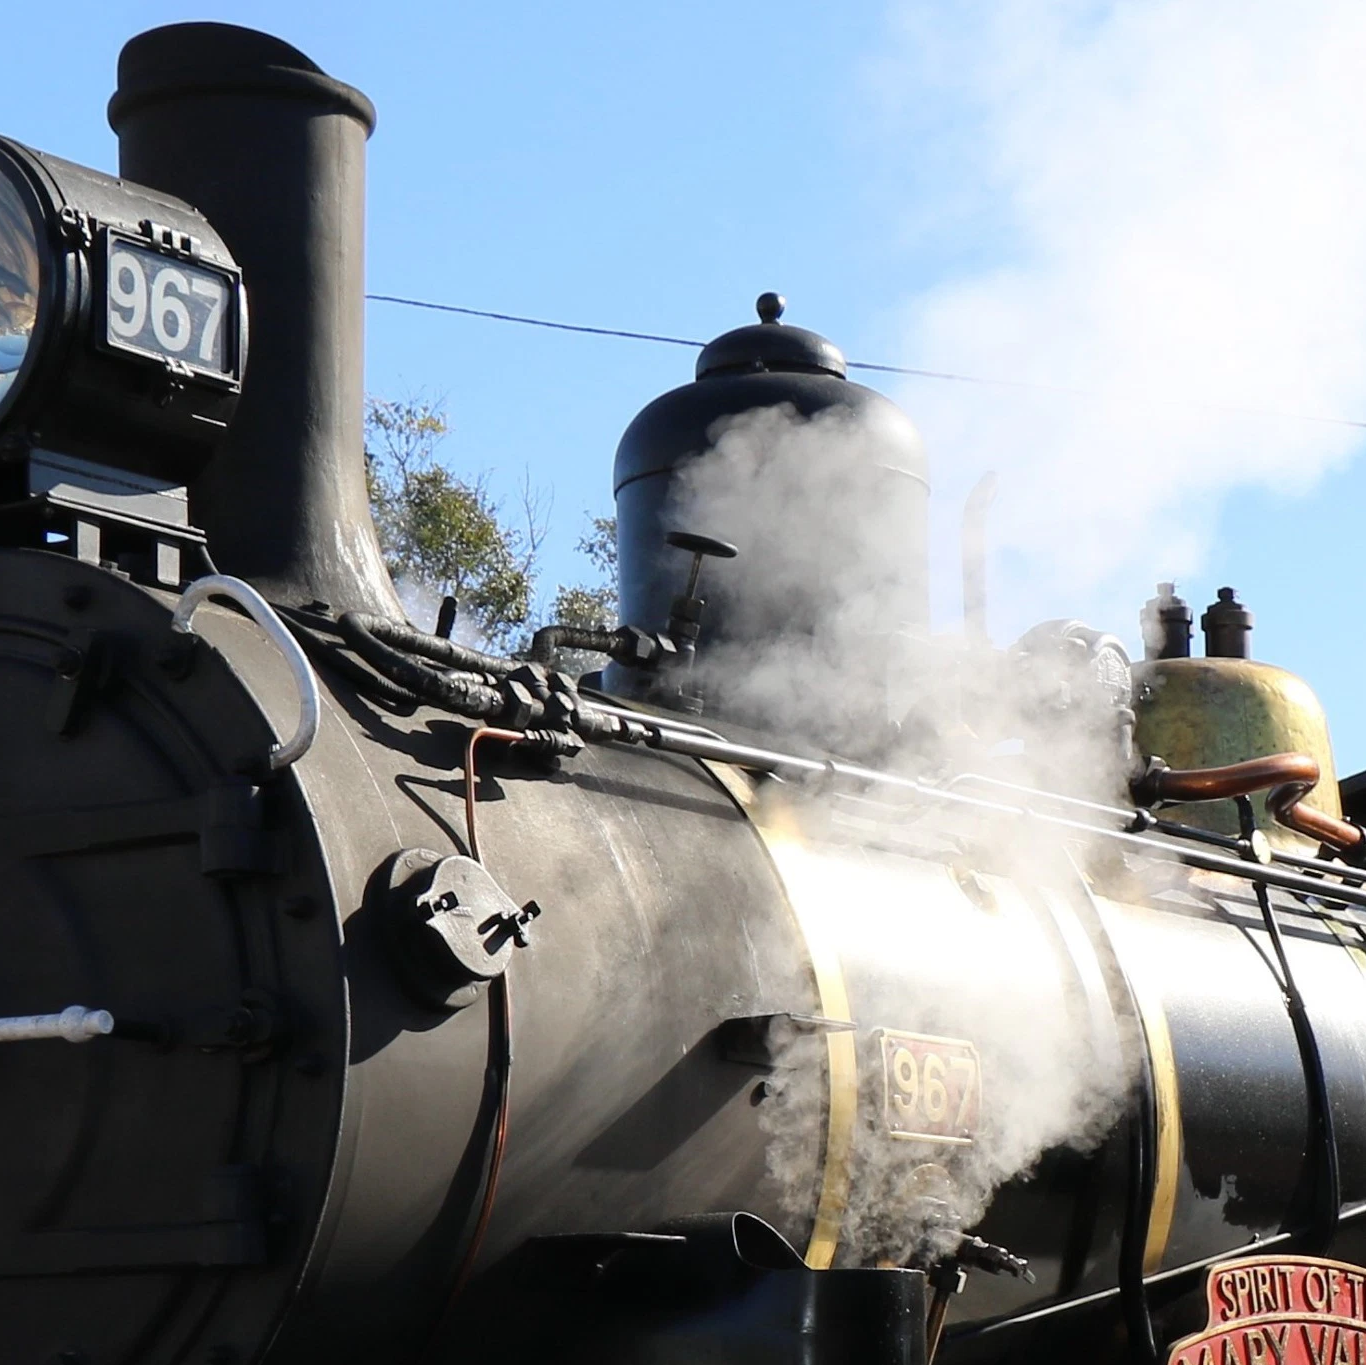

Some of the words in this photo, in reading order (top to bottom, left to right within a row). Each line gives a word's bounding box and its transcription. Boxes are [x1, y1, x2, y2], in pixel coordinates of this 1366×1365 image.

[109, 251, 223, 362] 967
[893, 1048, 976, 1127] 967
[1219, 1265, 1295, 1319] SPIRIT
[1304, 1266, 1343, 1312] OF
